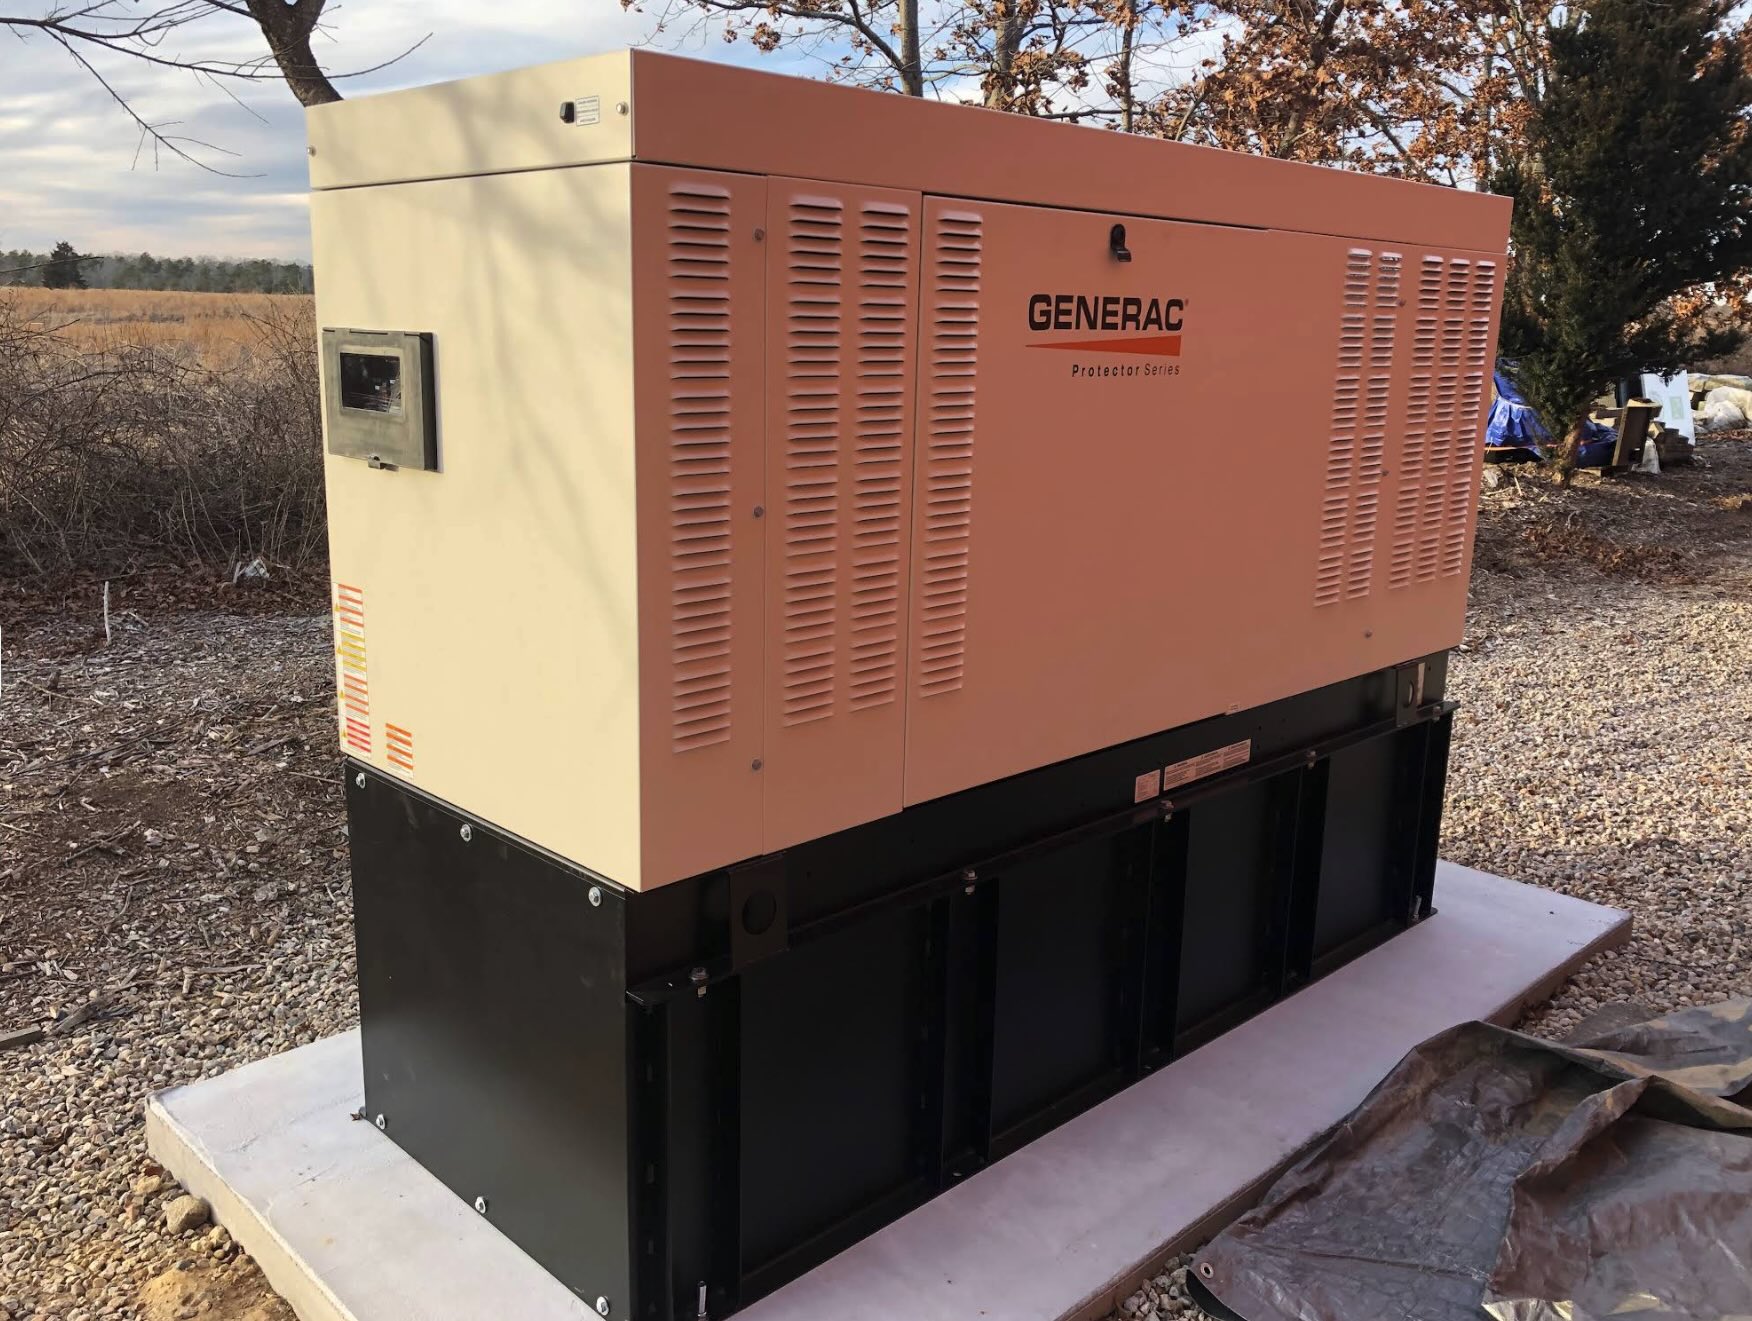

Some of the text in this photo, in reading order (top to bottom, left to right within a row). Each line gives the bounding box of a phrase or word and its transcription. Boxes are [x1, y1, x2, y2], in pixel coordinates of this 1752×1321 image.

[1028, 294, 1184, 331] GENERAC
[1072, 363, 1180, 377] Protector Series
